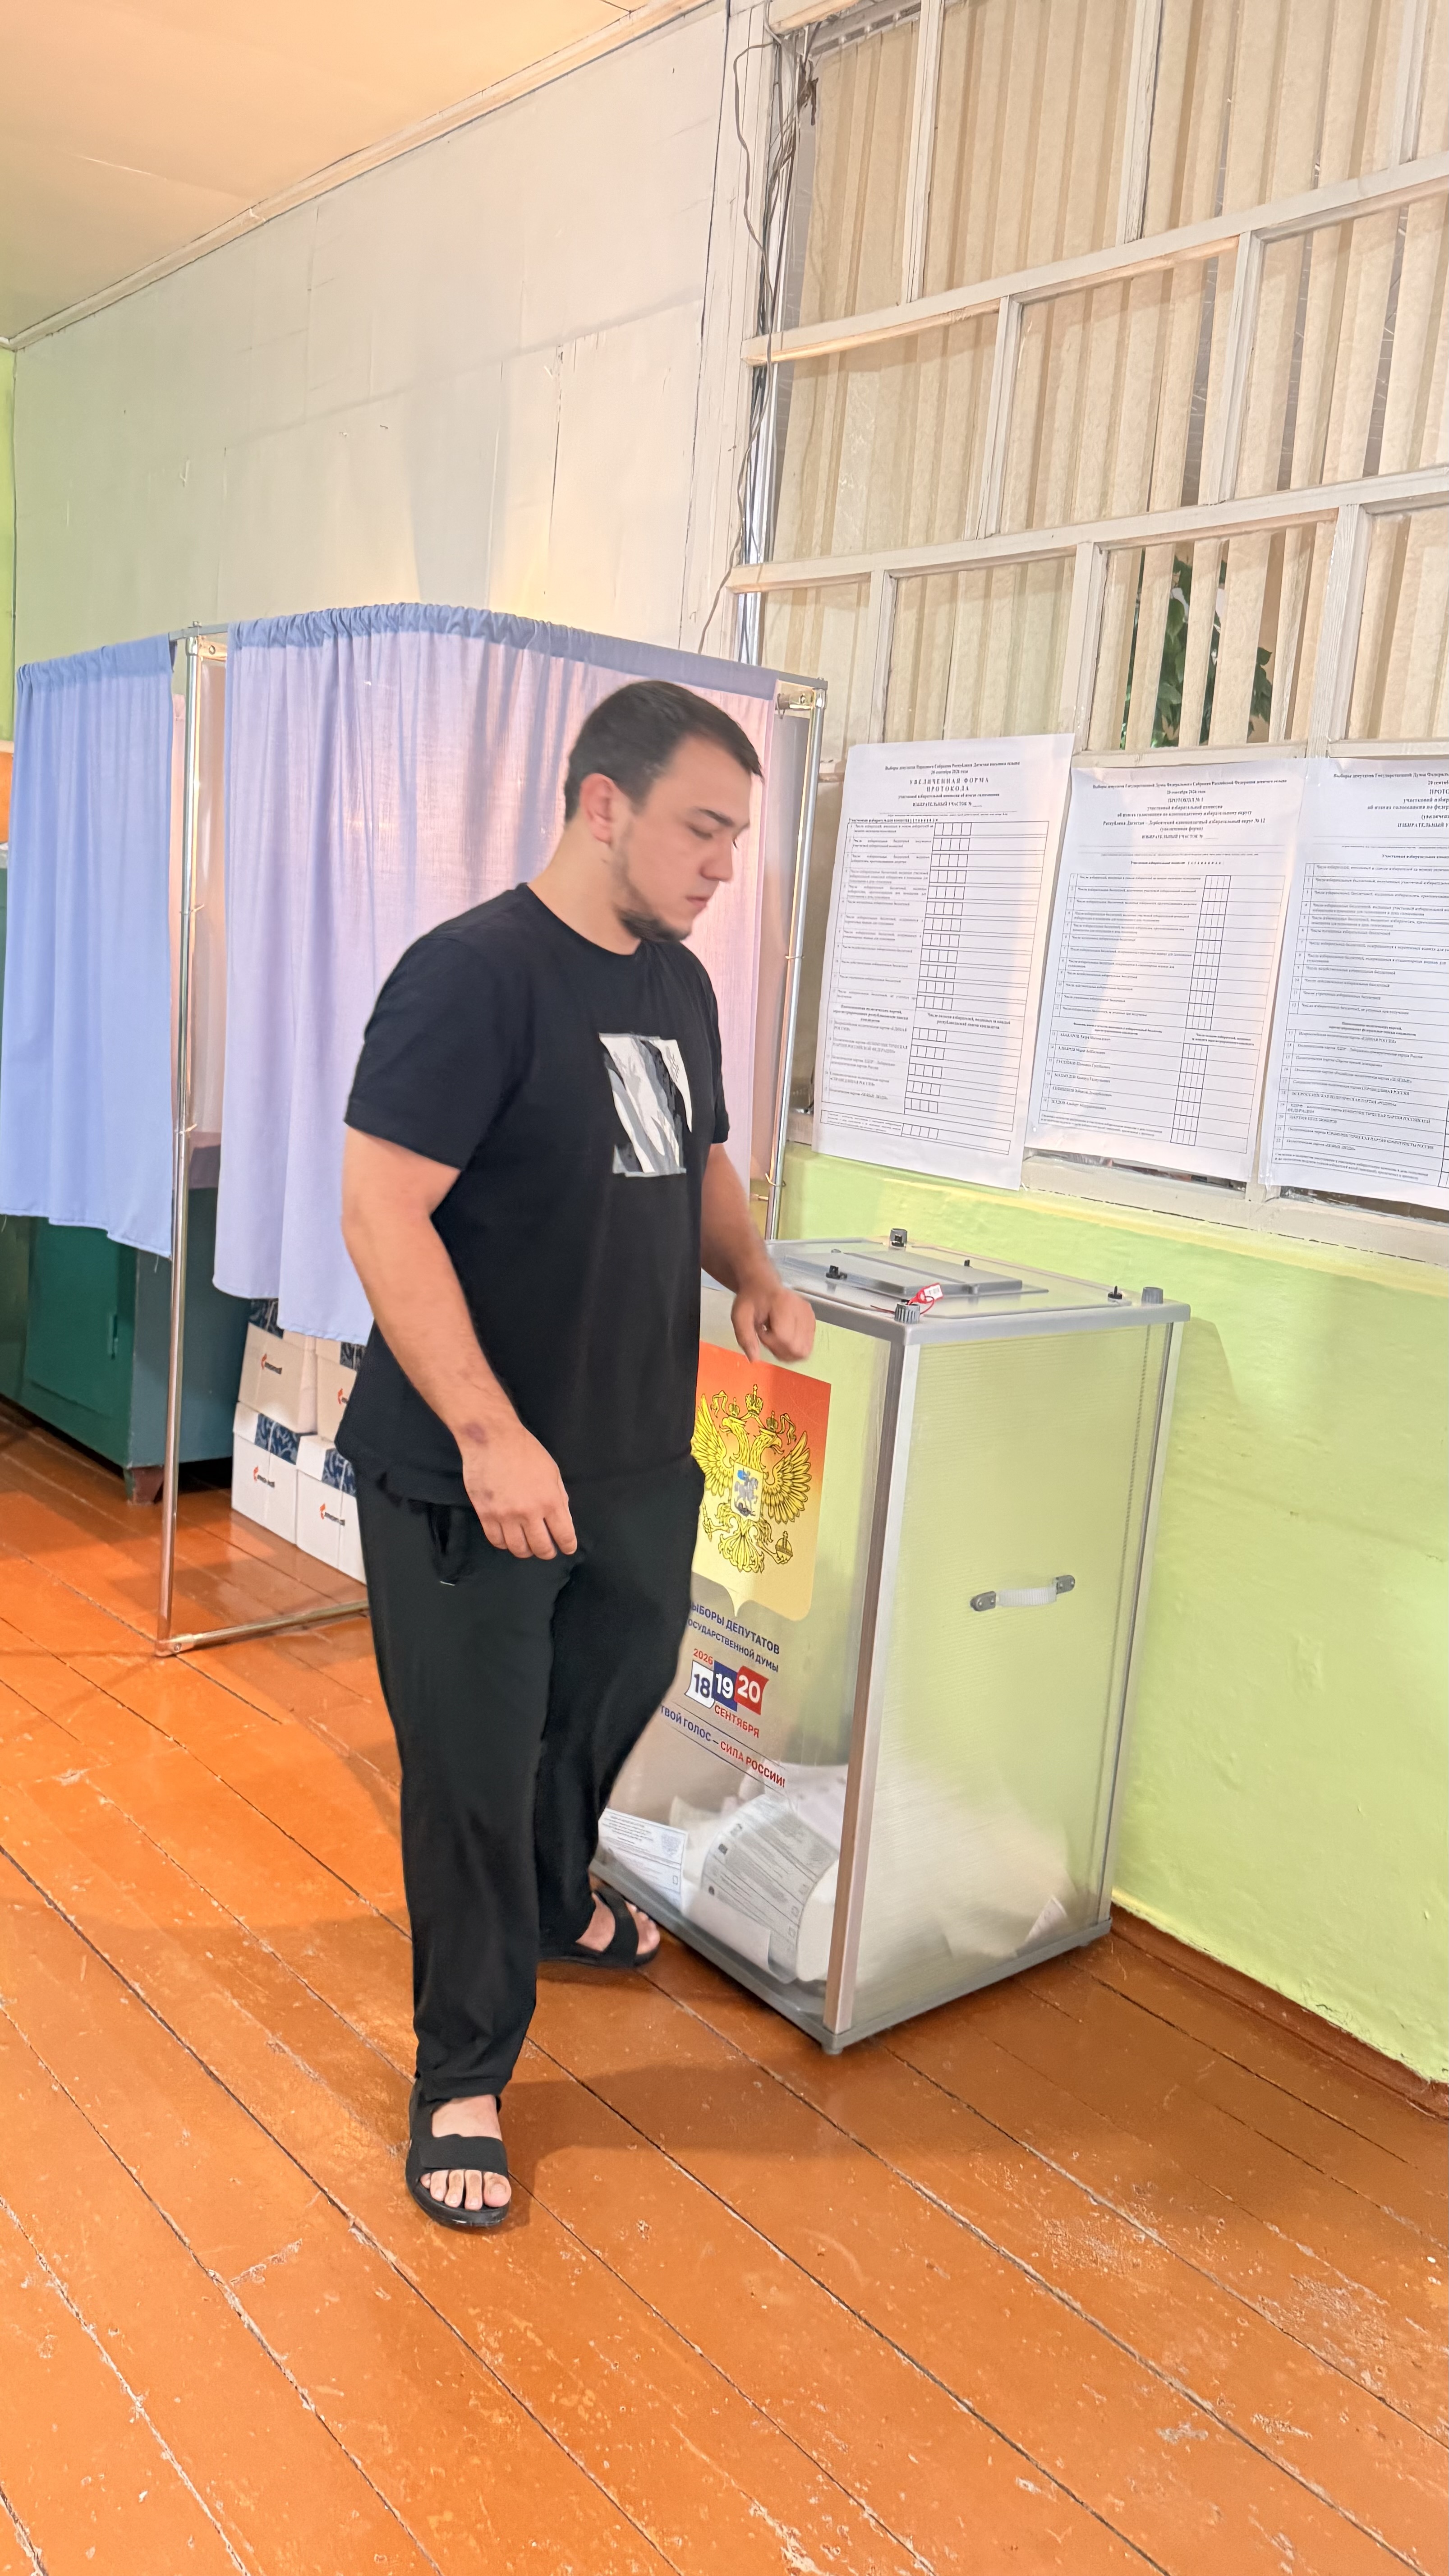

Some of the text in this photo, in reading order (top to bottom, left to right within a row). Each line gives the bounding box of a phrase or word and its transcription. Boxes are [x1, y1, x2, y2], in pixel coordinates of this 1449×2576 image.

[688, 1619, 779, 1673] ОСУДАРСТВЕННОЙ ДУМЫ
[692, 1602, 780, 1655] ЫБОРЫ ДЕПУТАТОВ
[693, 1648, 713, 1665] 2026
[694, 1673, 761, 1703] 18 19 20
[714, 1705, 760, 1738] СЕНТЯБРЯ
[661, 1706, 681, 1725] ТВОЙ
[683, 1718, 712, 1742] ГОЛОС
[720, 1741, 744, 1762] СИЛА
[746, 1756, 786, 1788] РОССИИ!
